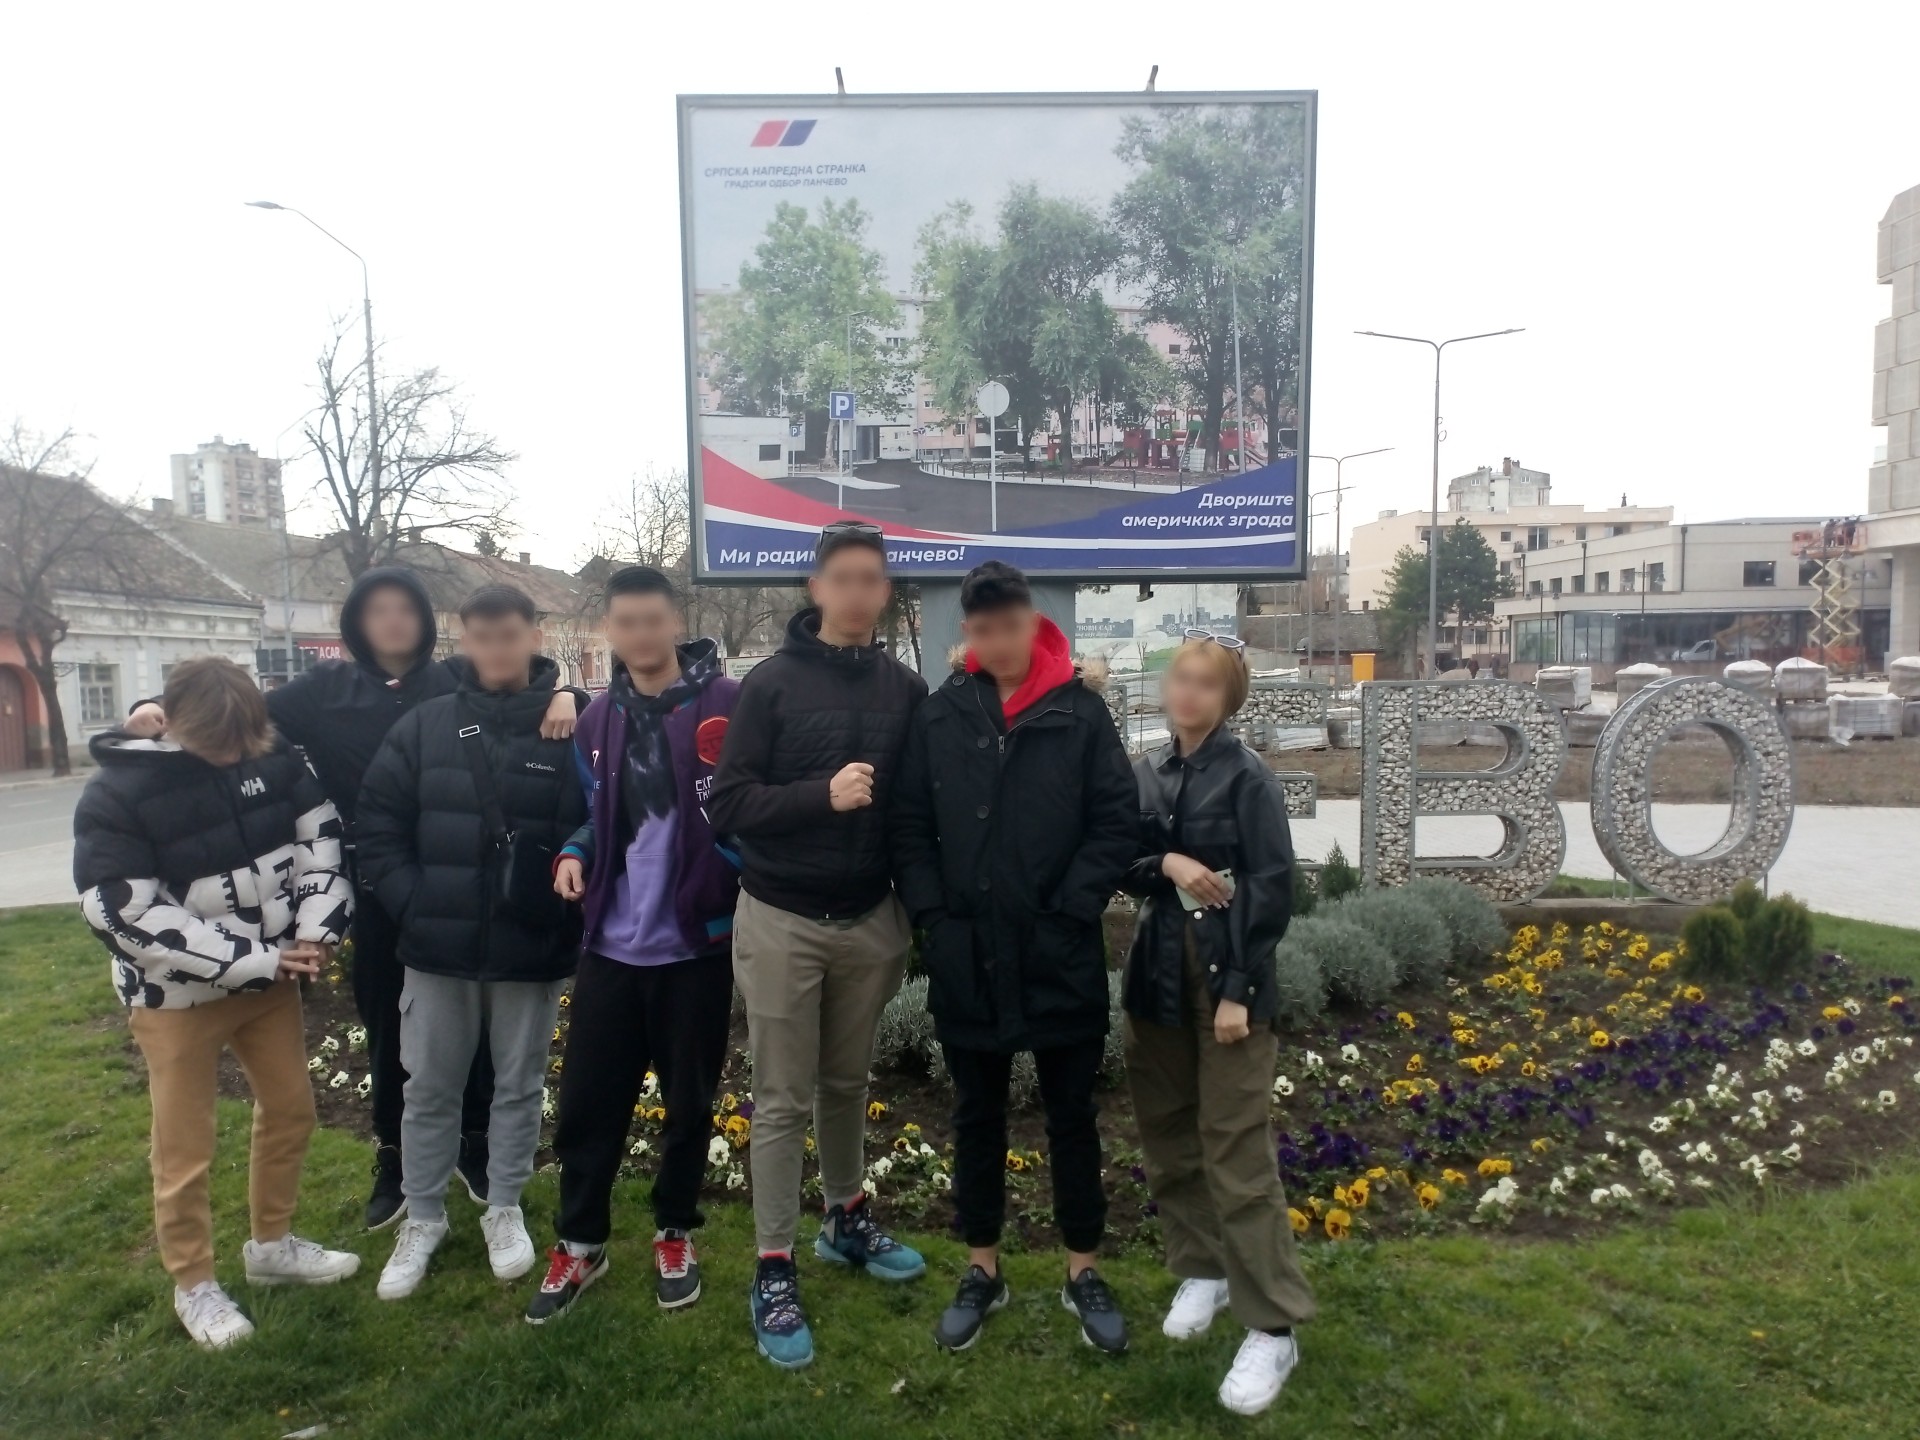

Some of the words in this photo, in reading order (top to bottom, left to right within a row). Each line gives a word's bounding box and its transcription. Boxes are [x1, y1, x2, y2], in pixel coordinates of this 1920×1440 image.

[704, 167, 749, 177] СРПСКА
[752, 166, 813, 177] НАПРЕДНА
[816, 164, 866, 175] СТРАНКА
[724, 180, 767, 189] ГРАДСКИ
[769, 179, 801, 188] ОДБОР
[803, 178, 848, 187] ПАНЧЕВО
[835, 395, 850, 416] P
[1198, 493, 1294, 509] Двориште
[1122, 515, 1224, 530] америчких
[1228, 515, 1294, 530] зграда
[720, 549, 751, 563] Ми
[887, 546, 966, 562] анчево!
[325, 646, 341, 659] CAR
[695, 775, 713, 791] EXP
